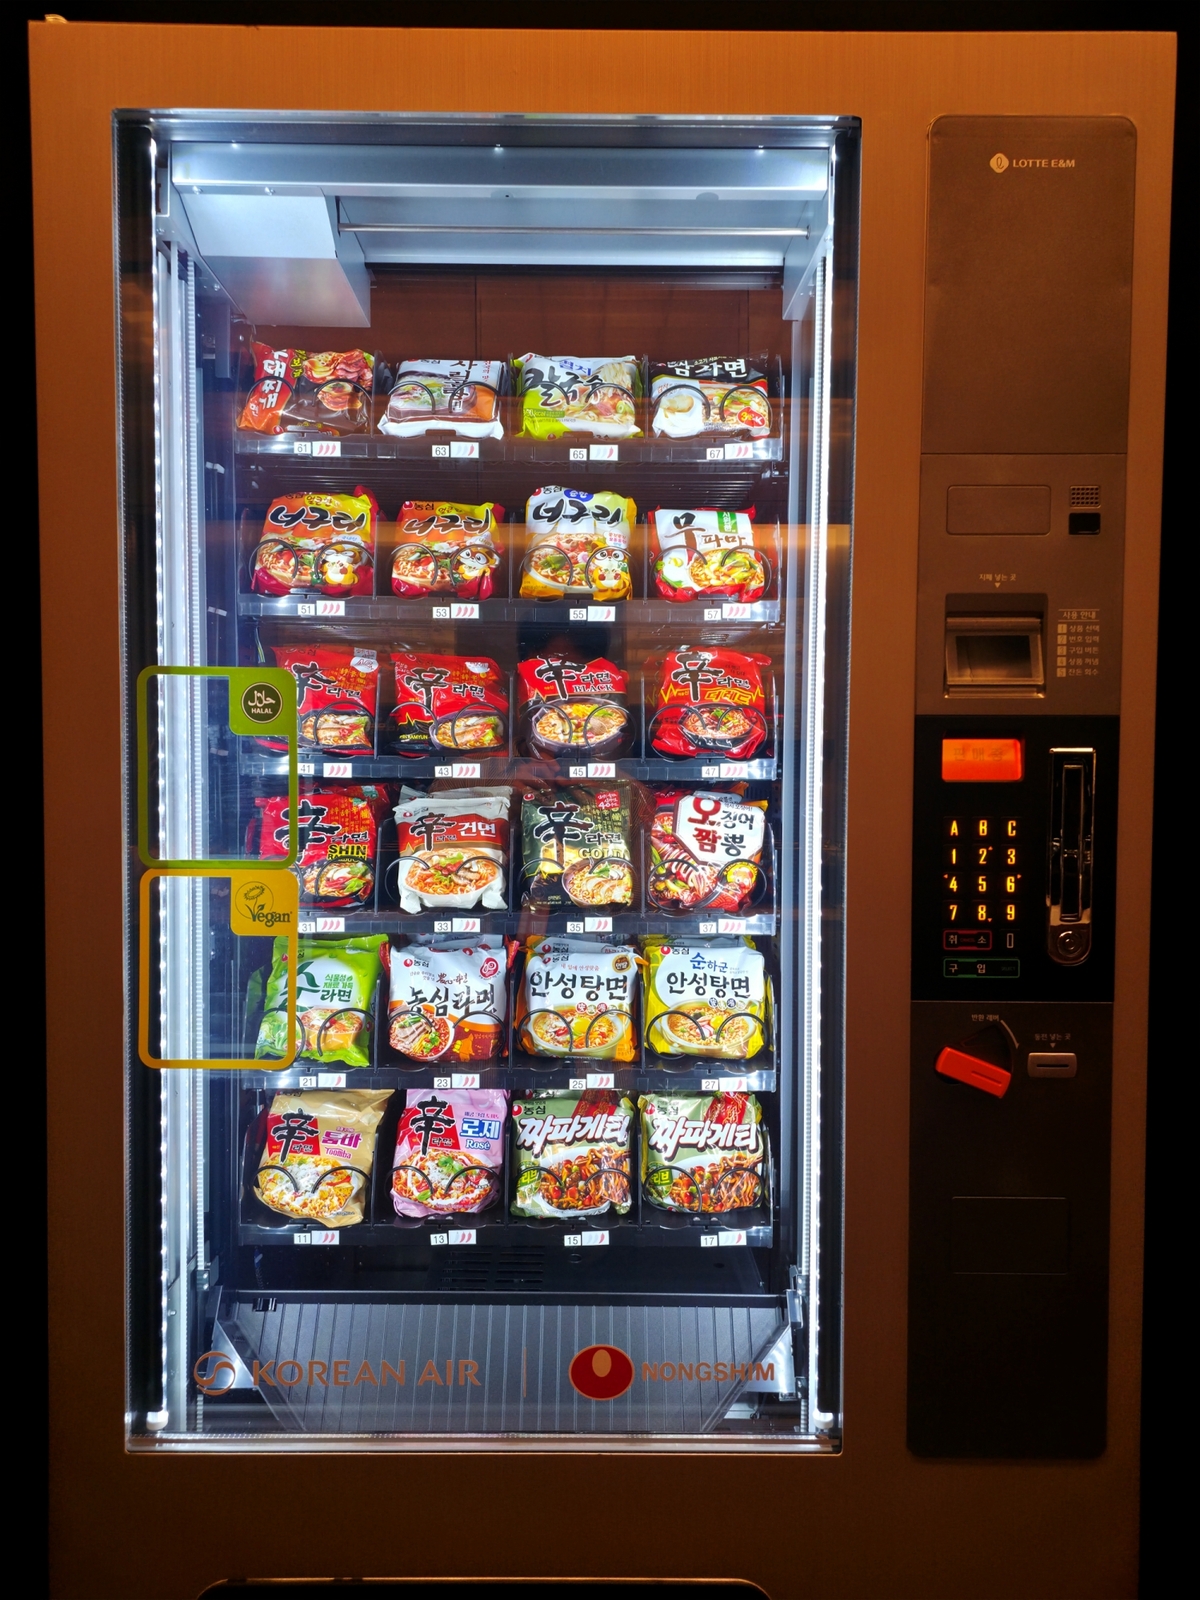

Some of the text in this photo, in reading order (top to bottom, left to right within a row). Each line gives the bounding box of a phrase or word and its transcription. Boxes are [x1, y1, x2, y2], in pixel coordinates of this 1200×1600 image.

[1012, 159, 1075, 168] LOTTE E&M
[297, 443, 307, 453] 61
[435, 446, 447, 456] 63
[572, 449, 584, 459] 65
[709, 449, 721, 459] 67
[414, 503, 435, 511] 농심
[532, 499, 622, 525] 너구리
[269, 505, 366, 533] 너구리
[403, 508, 490, 536] 너구리
[300, 605, 311, 614] 51
[435, 608, 447, 617] 53
[572, 609, 584, 619] 55
[707, 610, 719, 619] 57
[1062, 611, 1096, 620] 사용 안내
[1069, 625, 1083, 633] 상품
[1069, 646, 1083, 654] 구입
[1068, 657, 1082, 665] 상품
[581, 672, 611, 683] 라면
[716, 676, 751, 690] 라면
[405, 667, 450, 716] 辛
[452, 684, 486, 698] 라면
[573, 684, 615, 693] BLACK
[300, 764, 311, 774] 41
[437, 766, 449, 776] 43
[572, 767, 584, 776] 45
[704, 767, 716, 776] 47
[410, 812, 457, 852] 辛
[458, 821, 497, 838] 건면
[950, 820, 1016, 836] A B C
[533, 800, 595, 868] 辛
[585, 832, 621, 845] 라면
[692, 827, 747, 857] 짬뽕
[328, 844, 367, 856] SHIN
[951, 848, 1016, 865] 1 2 3
[949, 876, 1015, 892] 4 5 6
[245, 904, 291, 928] Vegan
[949, 905, 1015, 921] 7 8 9
[301, 922, 312, 932] 31
[437, 922, 448, 932] 33
[569, 922, 581, 932] 35
[702, 923, 713, 932] 37
[552, 945, 569, 953] 농심
[672, 948, 690, 956] 농심
[552, 954, 569, 963] 농심
[689, 952, 729, 974] 순하군
[324, 973, 347, 981] 식물성
[529, 971, 628, 1002] 안성탕면
[666, 971, 751, 999] 안성탕면
[320, 989, 352, 1003] 라면
[302, 1077, 313, 1087] 21
[436, 1078, 448, 1087] 23
[571, 1079, 583, 1089] 25
[704, 1080, 716, 1090] 27
[524, 1105, 546, 1116] 농심
[410, 1095, 456, 1156] 辛
[460, 1118, 501, 1140] 로제
[271, 1108, 320, 1164] 辛
[322, 1130, 362, 1149] 툼바
[516, 1113, 631, 1158] 짜파게티
[648, 1116, 758, 1162] 짜파게티
[432, 1137, 453, 1147] 라면
[465, 1139, 491, 1151] Rosé
[325, 1147, 352, 1160] Toomba
[297, 1233, 307, 1243] 11
[433, 1234, 445, 1244] 13
[567, 1236, 579, 1245] 15
[703, 1236, 715, 1246] 17
[252, 1359, 482, 1387] KOREAN AIR
[640, 1360, 775, 1383] NONGSHIM
